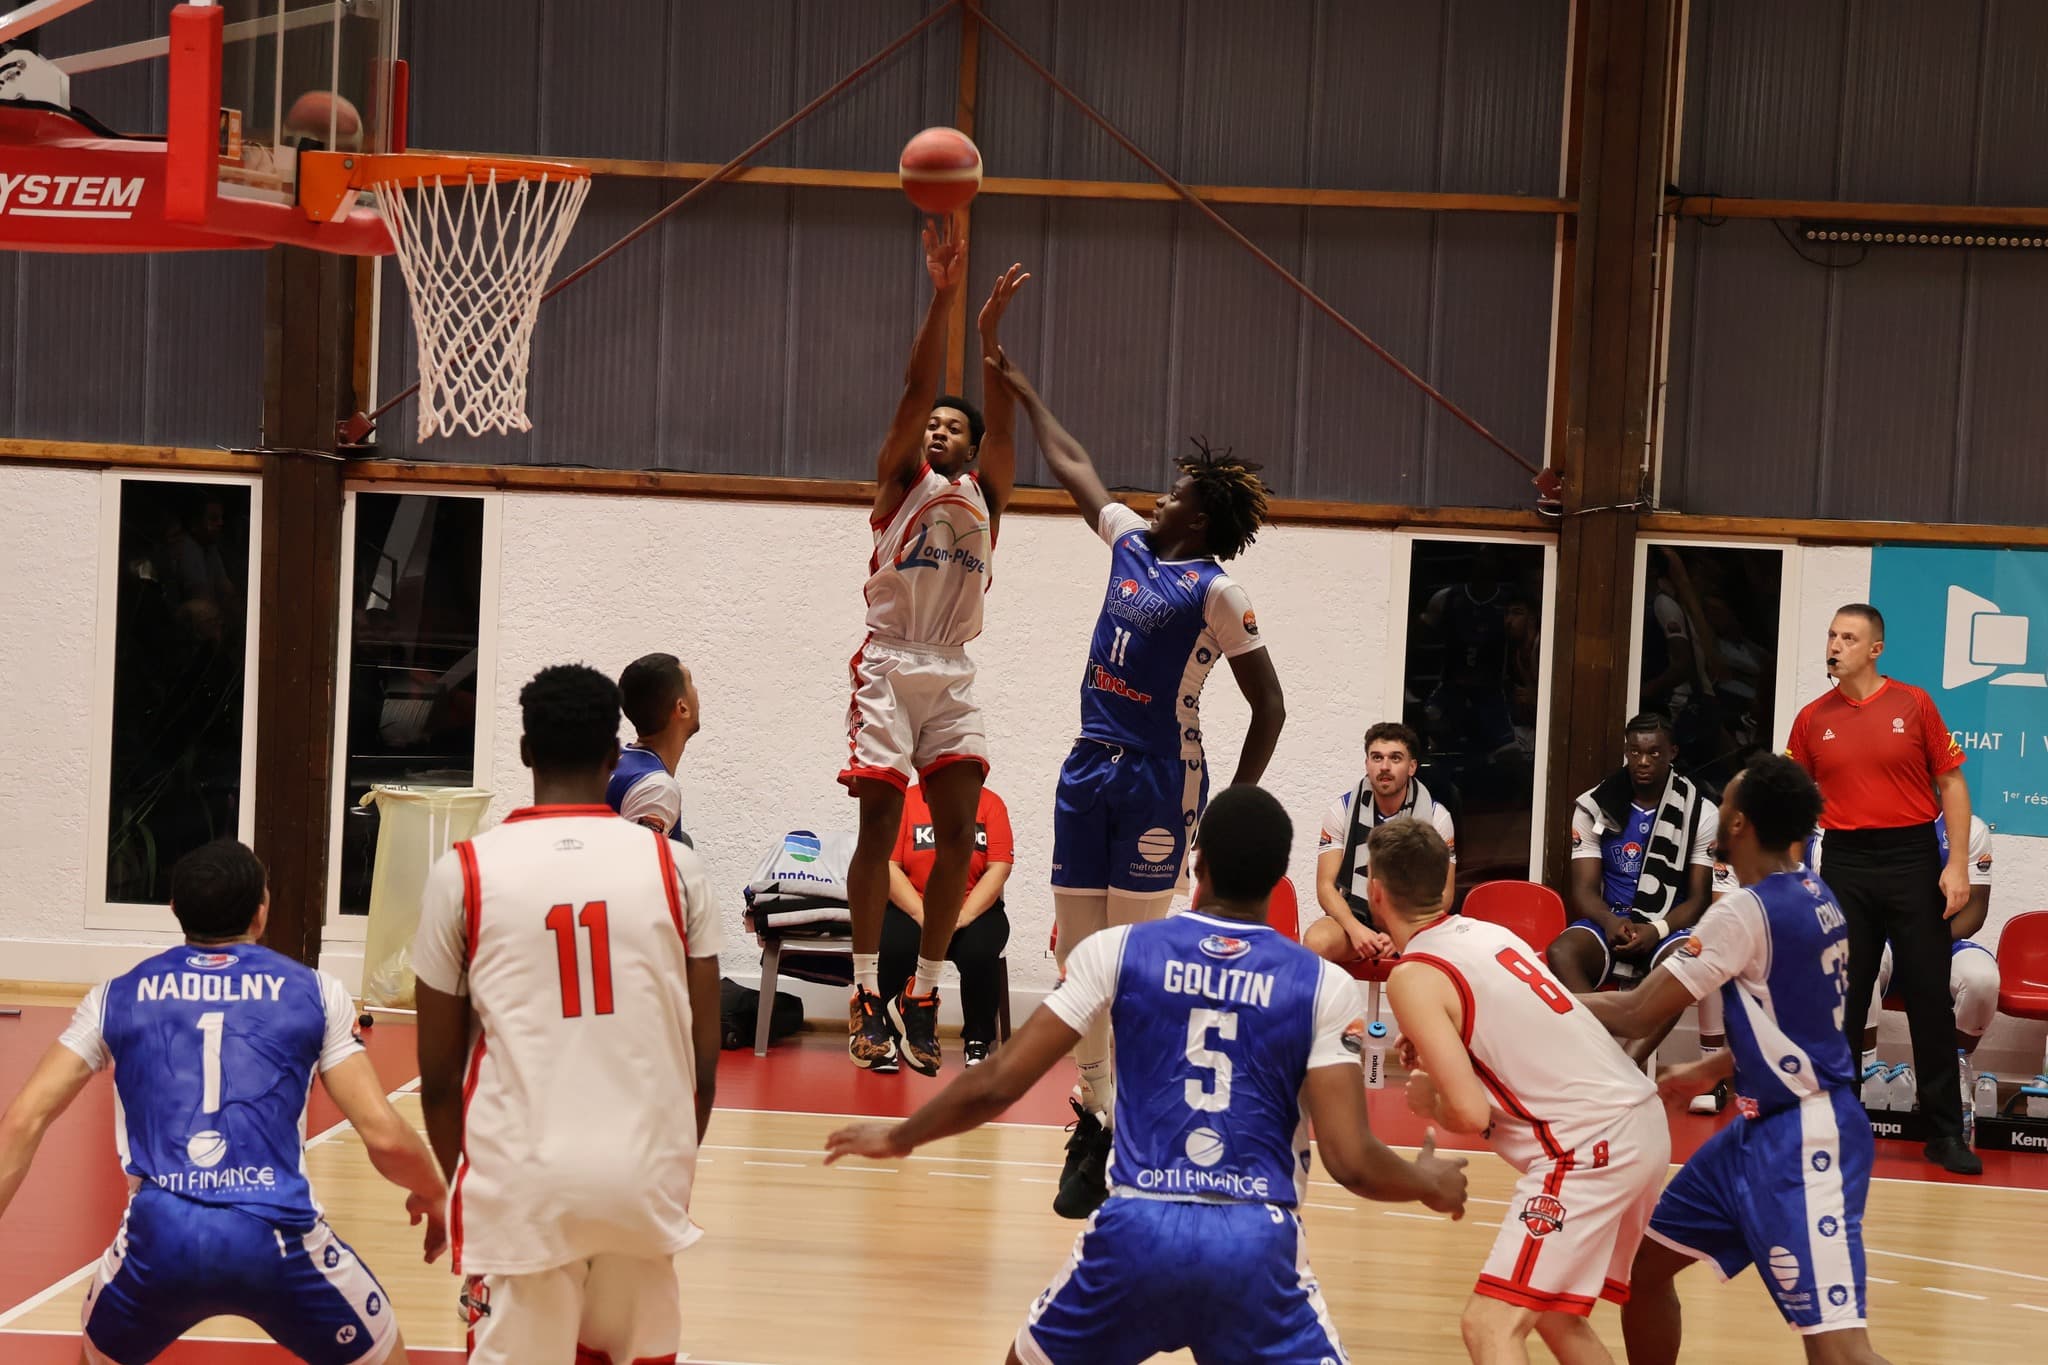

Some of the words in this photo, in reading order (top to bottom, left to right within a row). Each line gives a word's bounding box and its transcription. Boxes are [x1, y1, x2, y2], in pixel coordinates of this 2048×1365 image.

[896, 522, 985, 573] Loon-Plage
[1110, 626, 1132, 667] 11
[1130, 861, 1175, 873] métropole
[544, 899, 615, 1019] 11
[1494, 946, 1574, 1015] 8
[136, 971, 286, 1003] NADOLNY
[1163, 959, 1275, 1008] GOLITIN
[195, 1011, 225, 1115] 1
[1184, 1007, 1239, 1113] 5
[1369, 1054, 1379, 1084] Kempa
[1592, 1139, 1610, 1169] 8
[1136, 1168, 1181, 1189] OPTI
